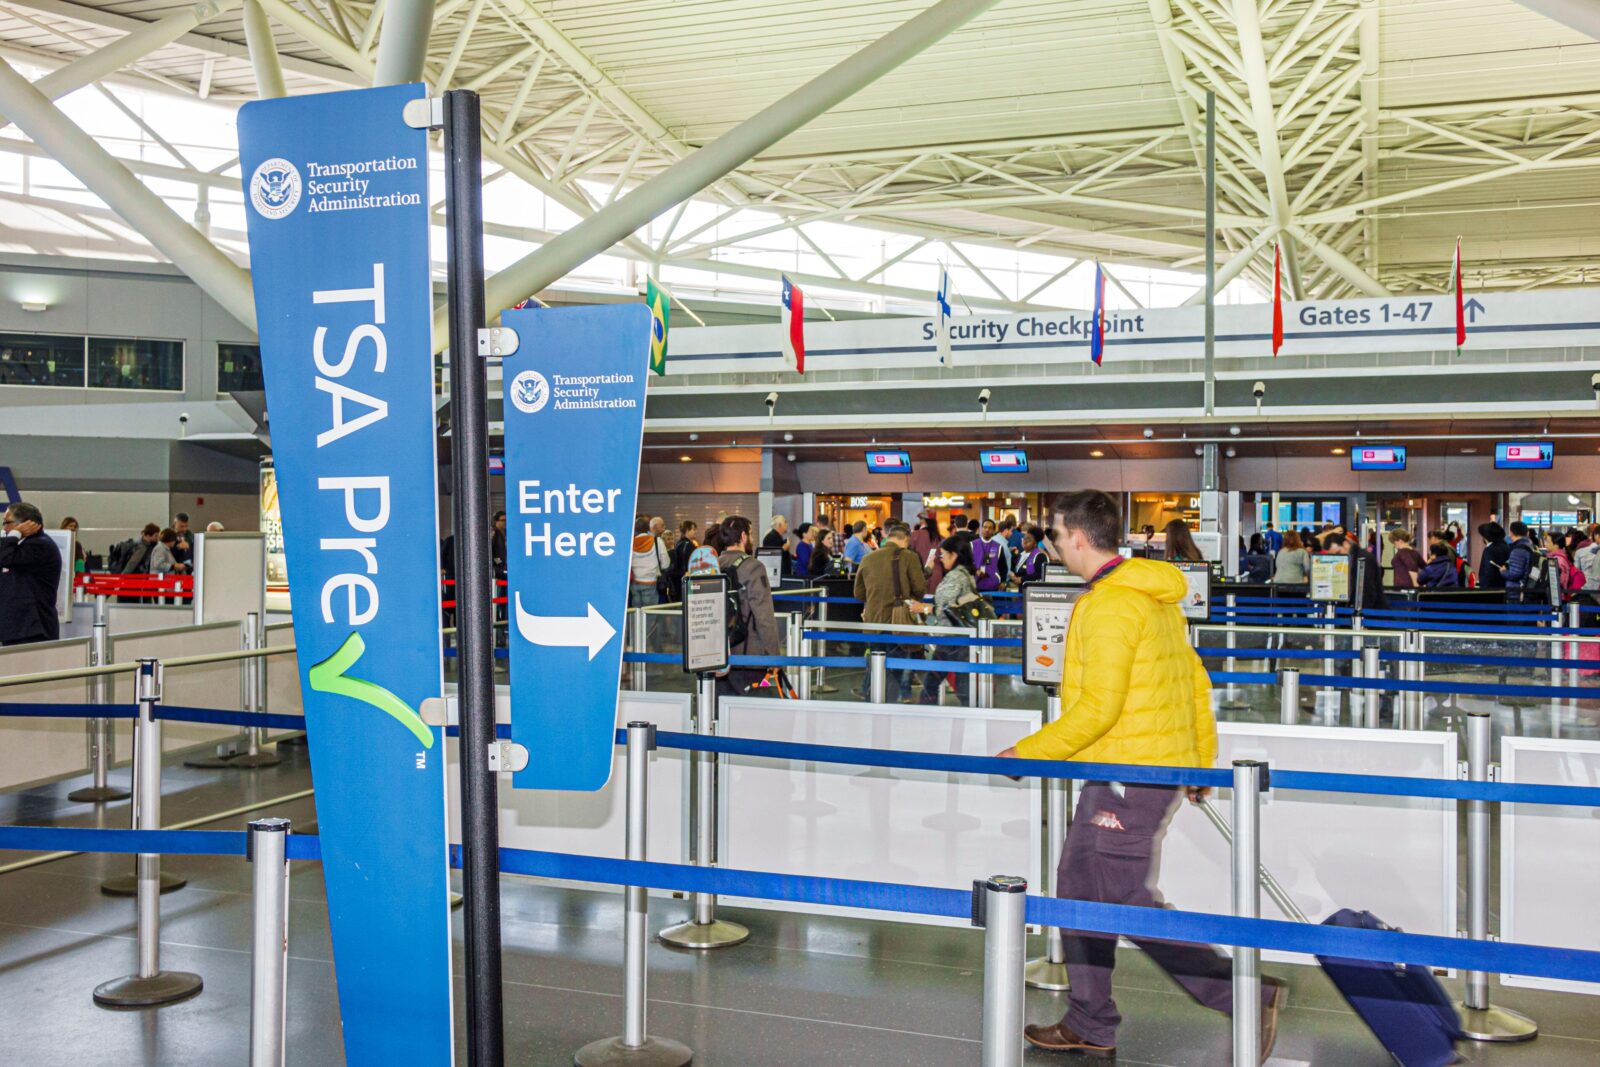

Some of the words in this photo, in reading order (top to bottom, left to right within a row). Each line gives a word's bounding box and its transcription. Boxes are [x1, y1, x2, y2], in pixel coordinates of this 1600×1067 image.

[307, 156, 418, 178] Transportation
[307, 177, 370, 196] Security
[308, 191, 421, 213] Administration
[1299, 305, 1371, 326] Gates
[1379, 301, 1433, 323] 1-47
[922, 318, 1009, 342] Scurity
[312, 263, 389, 449] TSA
[552, 372, 634, 388] Transportation
[553, 386, 600, 399] Security
[553, 397, 637, 410] Administration
[518, 479, 622, 514] Enter
[317, 475, 391, 626] Pre
[524, 522, 617, 557] Here
[415, 750, 426, 769] TM
